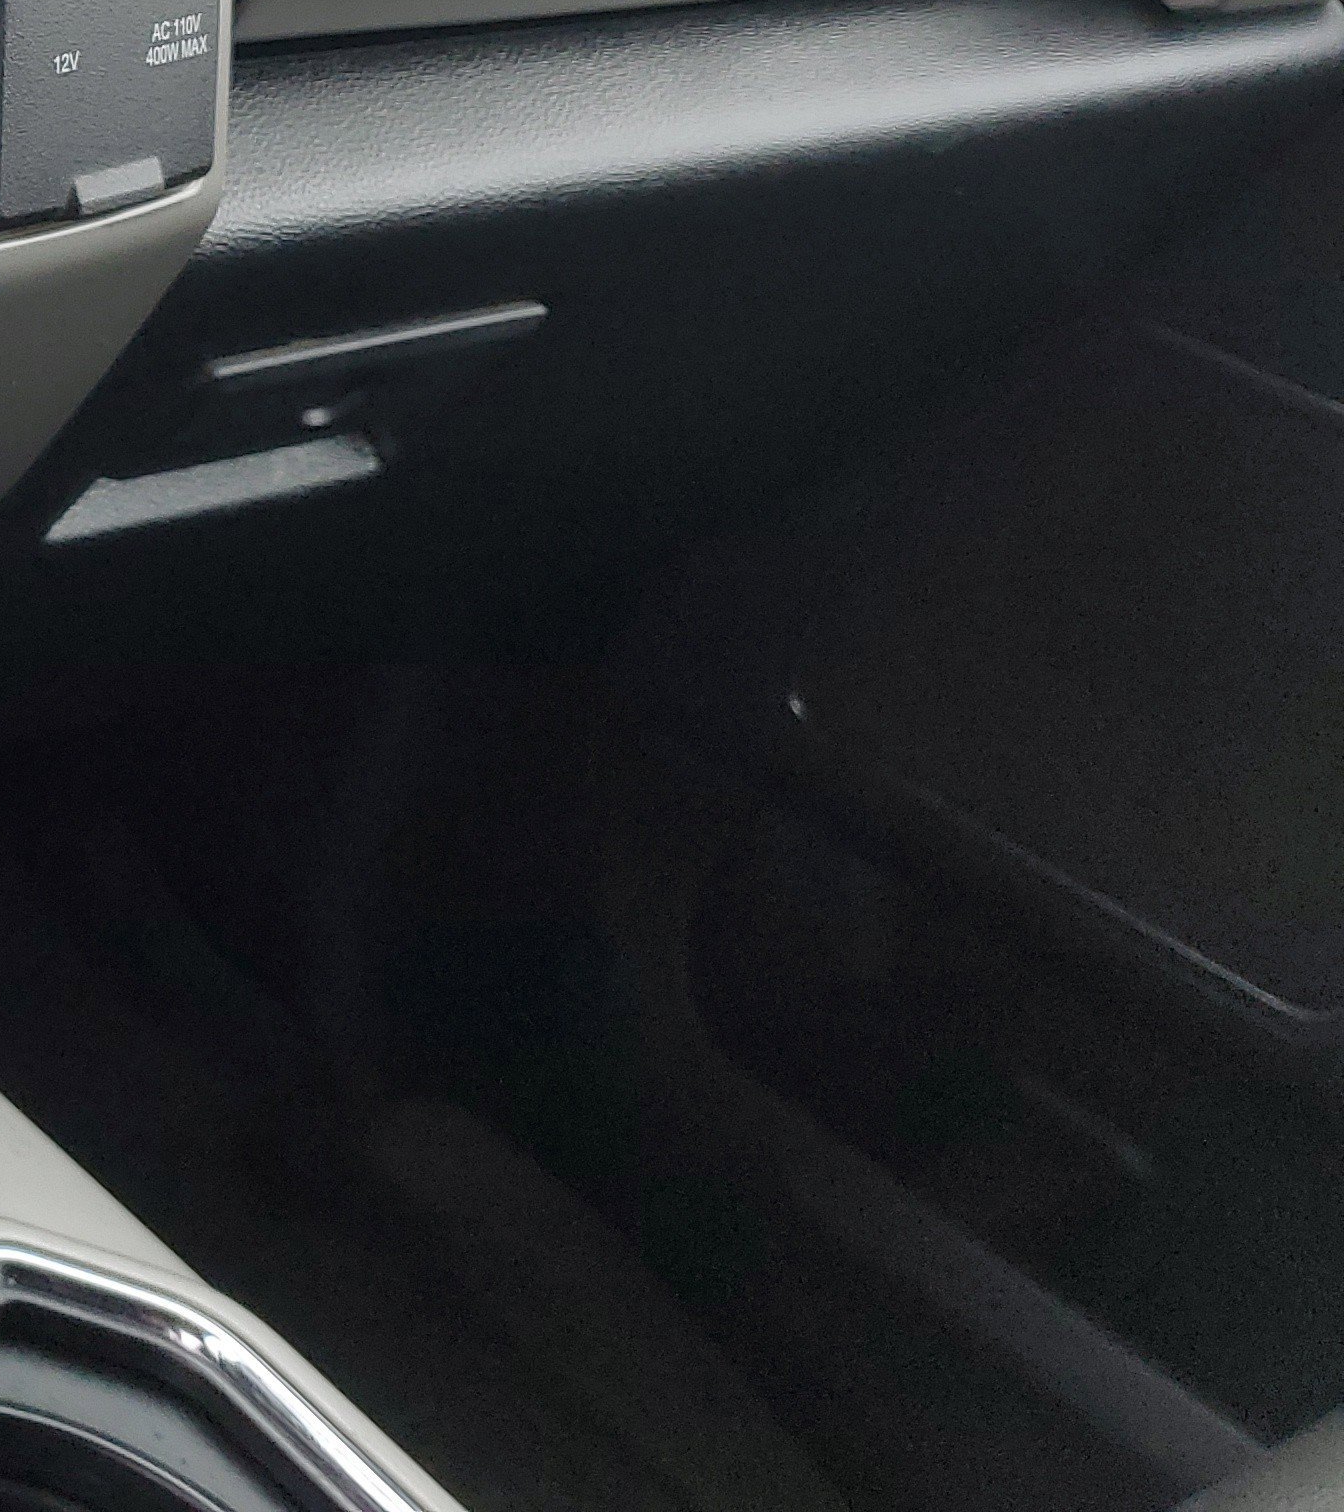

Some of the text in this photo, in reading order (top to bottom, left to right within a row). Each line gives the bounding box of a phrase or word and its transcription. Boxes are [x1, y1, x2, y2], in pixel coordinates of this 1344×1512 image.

[152, 13, 203, 43] AC 110V
[53, 51, 80, 75] 12V
[145, 34, 209, 67] 400W MAX
